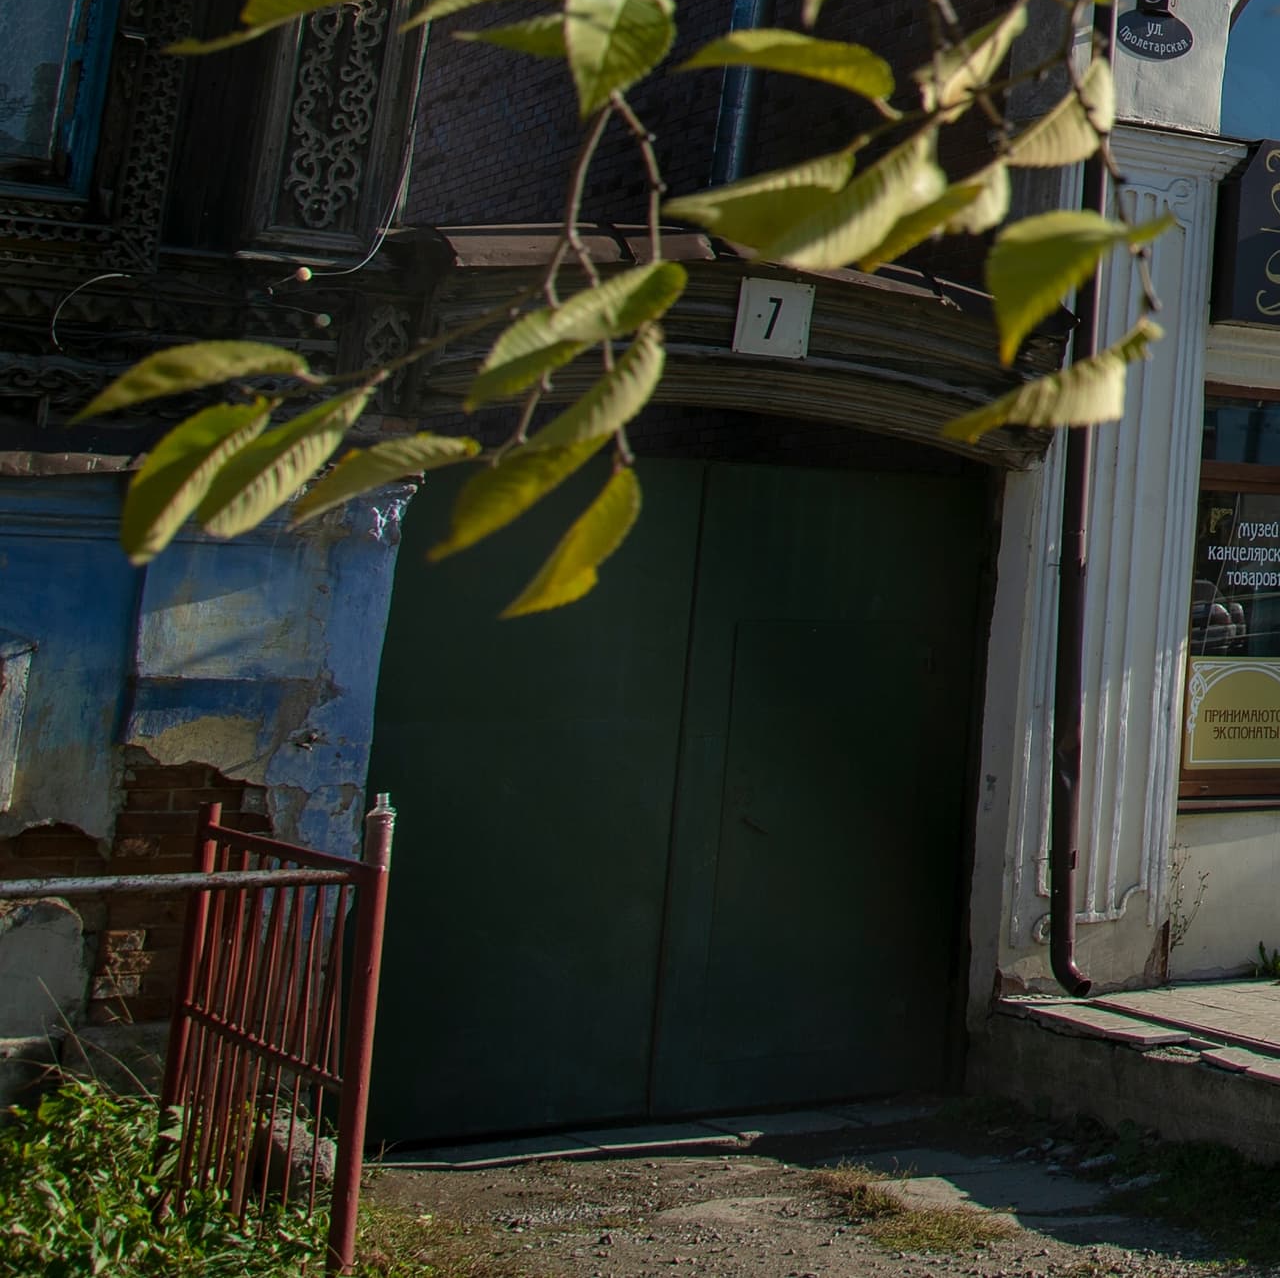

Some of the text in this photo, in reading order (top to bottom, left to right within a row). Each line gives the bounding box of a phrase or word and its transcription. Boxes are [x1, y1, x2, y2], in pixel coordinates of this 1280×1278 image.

[1119, 25, 1189, 55] Пролетарская
[1147, 22, 1164, 37] ул.
[764, 297, 783, 339] 7
[1213, 725, 1280, 739] ЭКСПОНАТЫ
